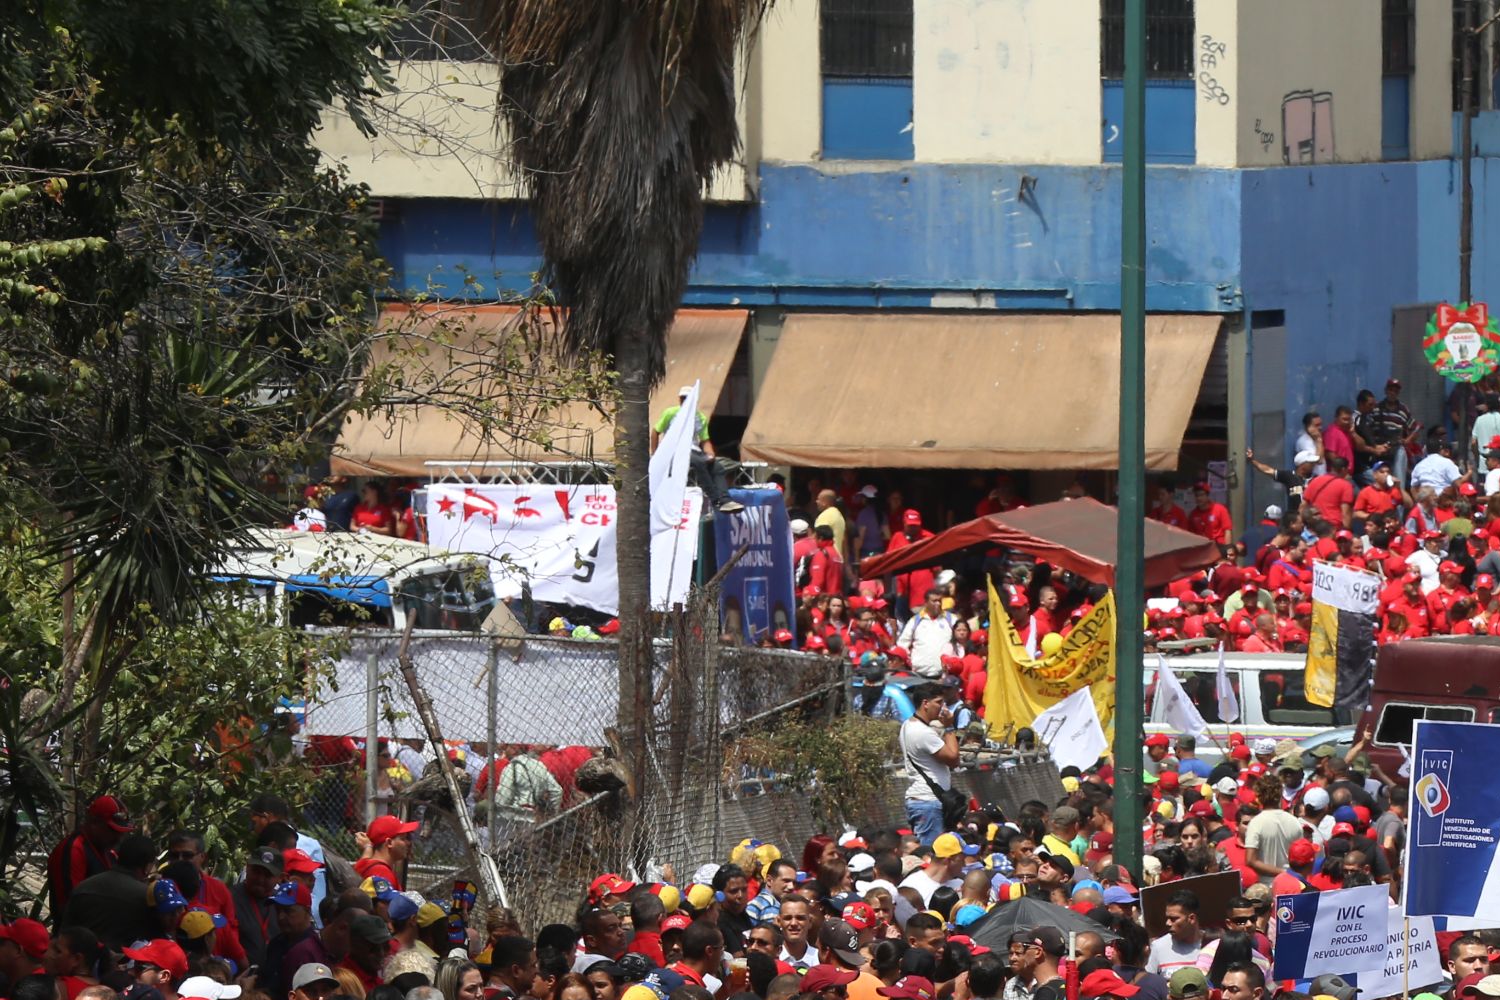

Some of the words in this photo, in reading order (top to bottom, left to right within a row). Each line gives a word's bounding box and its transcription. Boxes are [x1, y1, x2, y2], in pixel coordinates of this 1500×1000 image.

[731, 550, 774, 568] OMUNAL
[1443, 825, 1481, 834] VENEZOLANO
[1442, 834, 1495, 843] INVESTIGACIONES
[1336, 904, 1366, 921] IVIC
[1335, 924, 1351, 933] CON
[1351, 923, 1362, 932] EL
[1330, 933, 1368, 946] PROCESO
[1313, 943, 1384, 960] REVOLUCIONARIO
[1383, 959, 1418, 978] NUEVA
